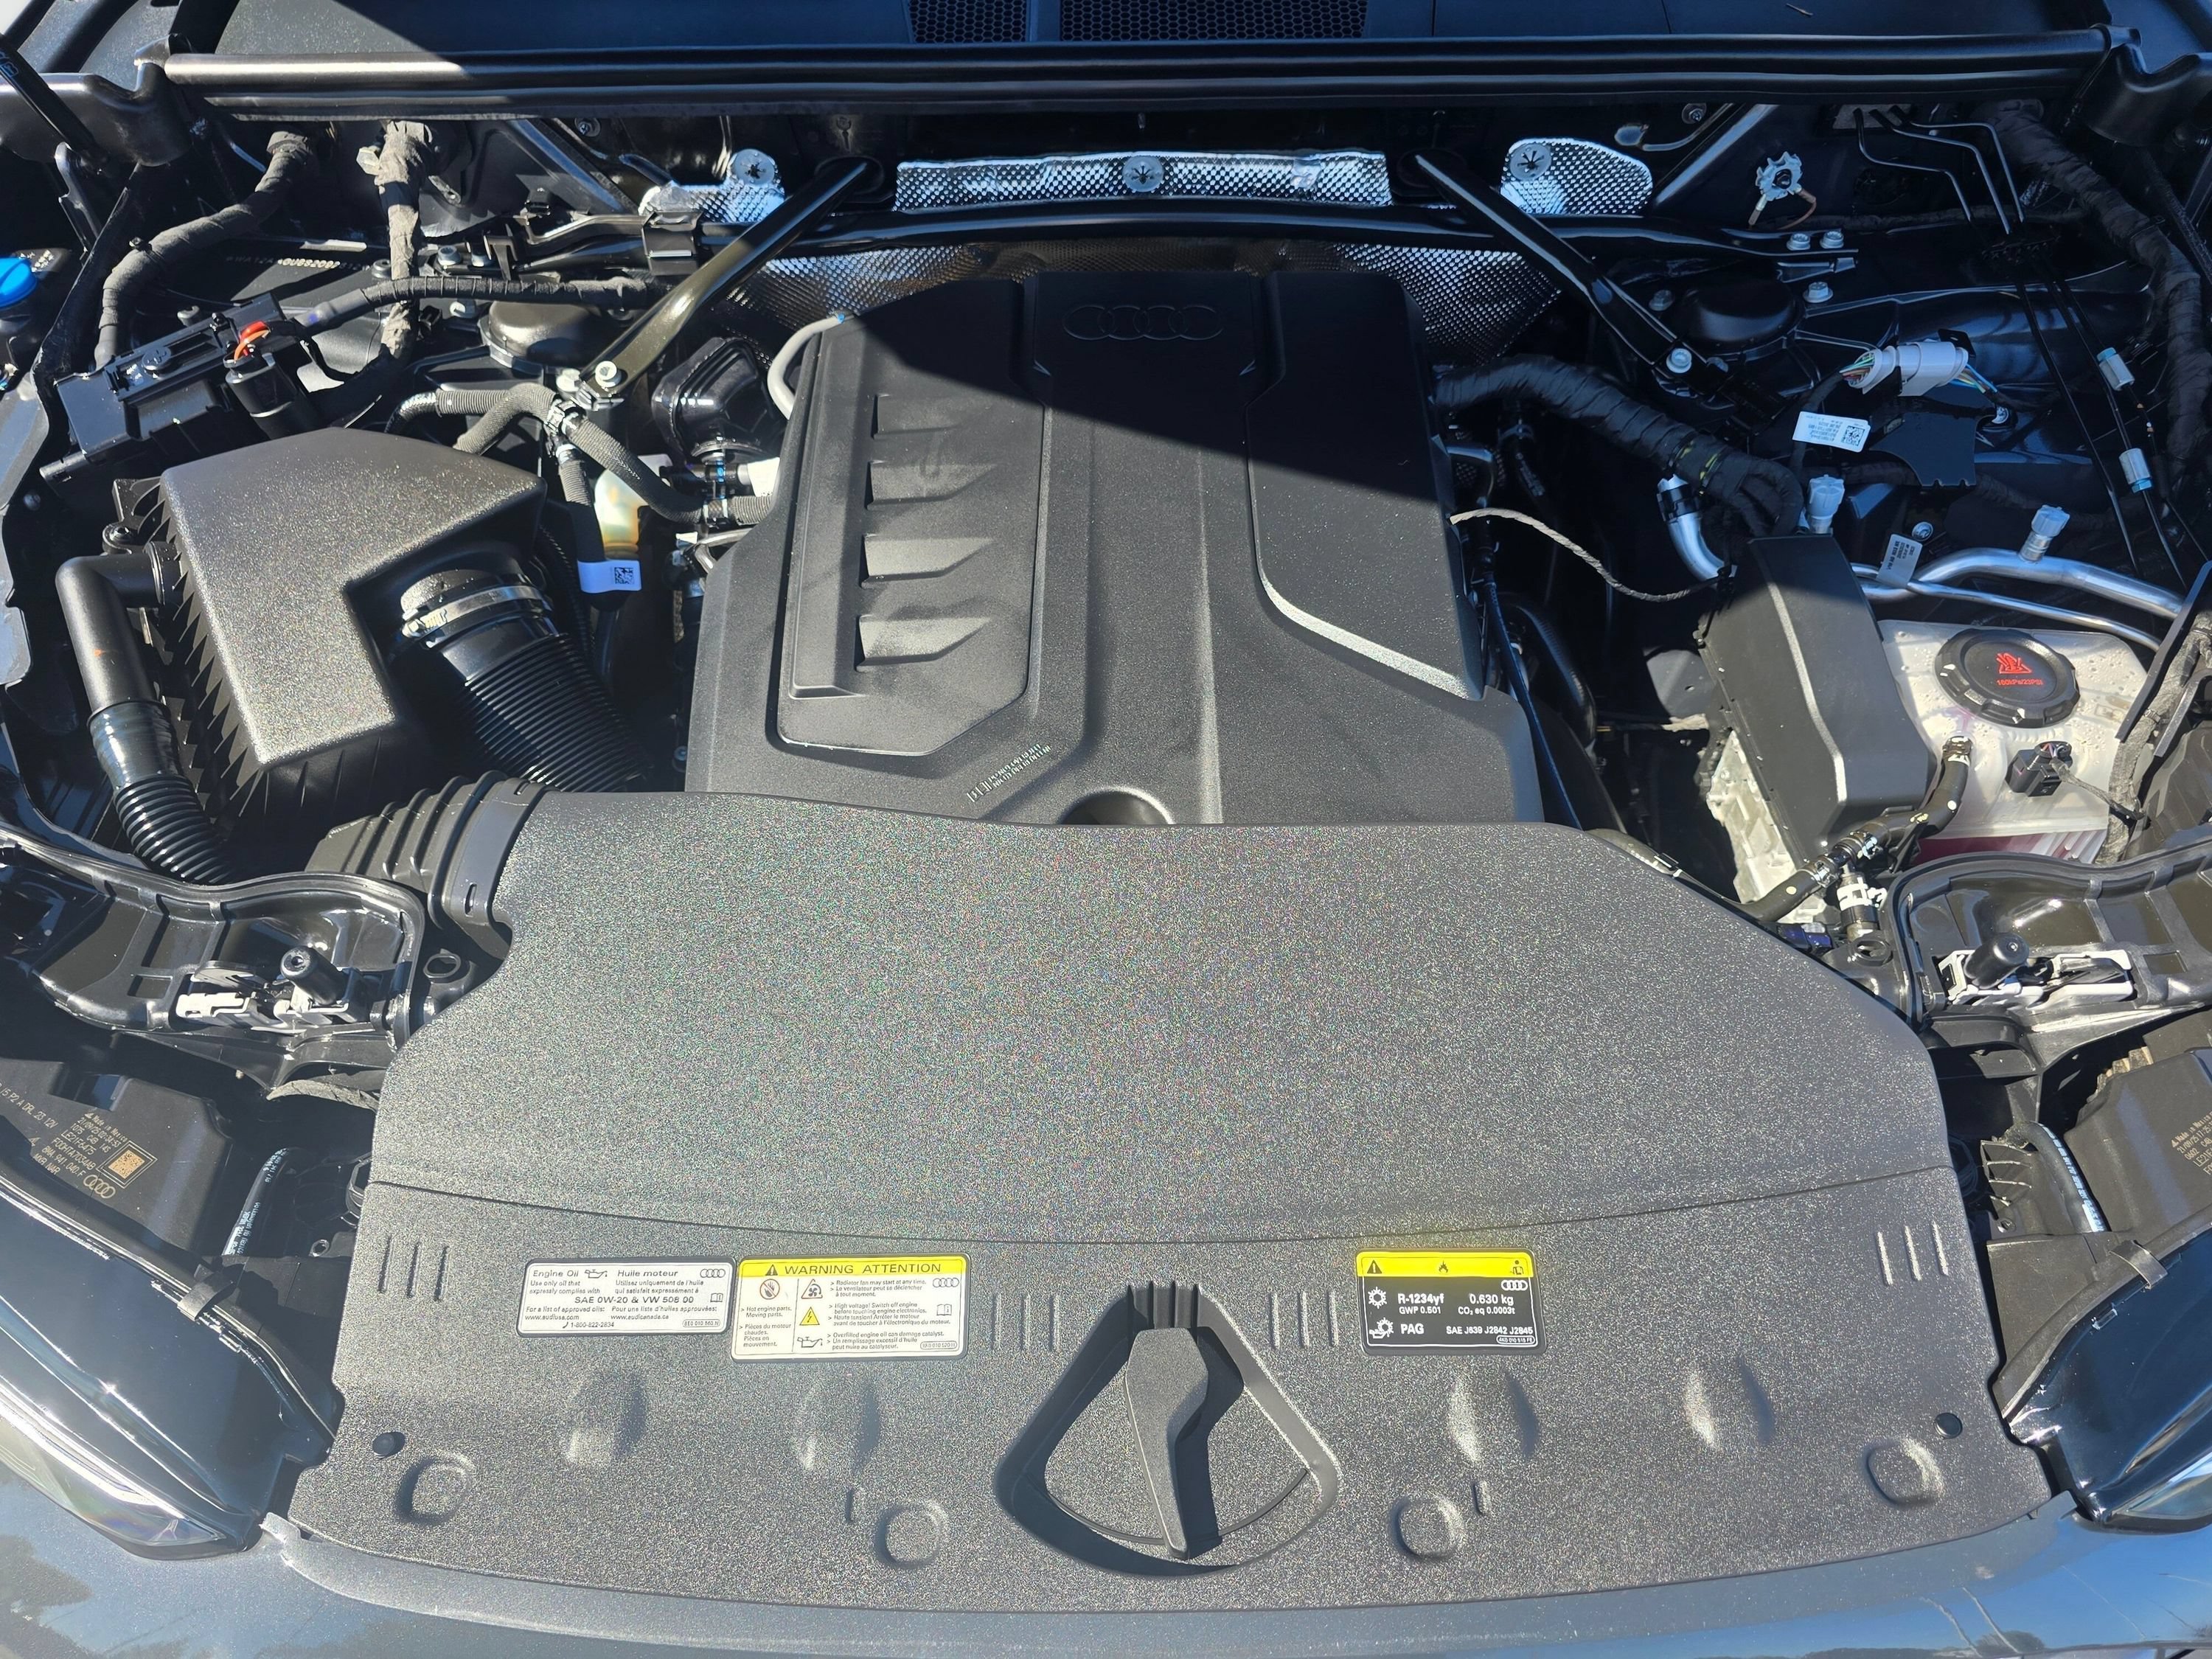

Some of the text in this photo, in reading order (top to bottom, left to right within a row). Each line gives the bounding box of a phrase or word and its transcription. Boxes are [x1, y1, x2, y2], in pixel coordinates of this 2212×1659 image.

[785, 1263, 941, 1274] WARNING ATTENTION
[1398, 1293, 1514, 1306] R-1234yf 0.630 kg
[1486, 1307, 1516, 1315] 0.0003t
[1401, 1324, 1425, 1334] PAG
[1446, 1326, 1533, 1335] SAE J639 J2842 J2845
